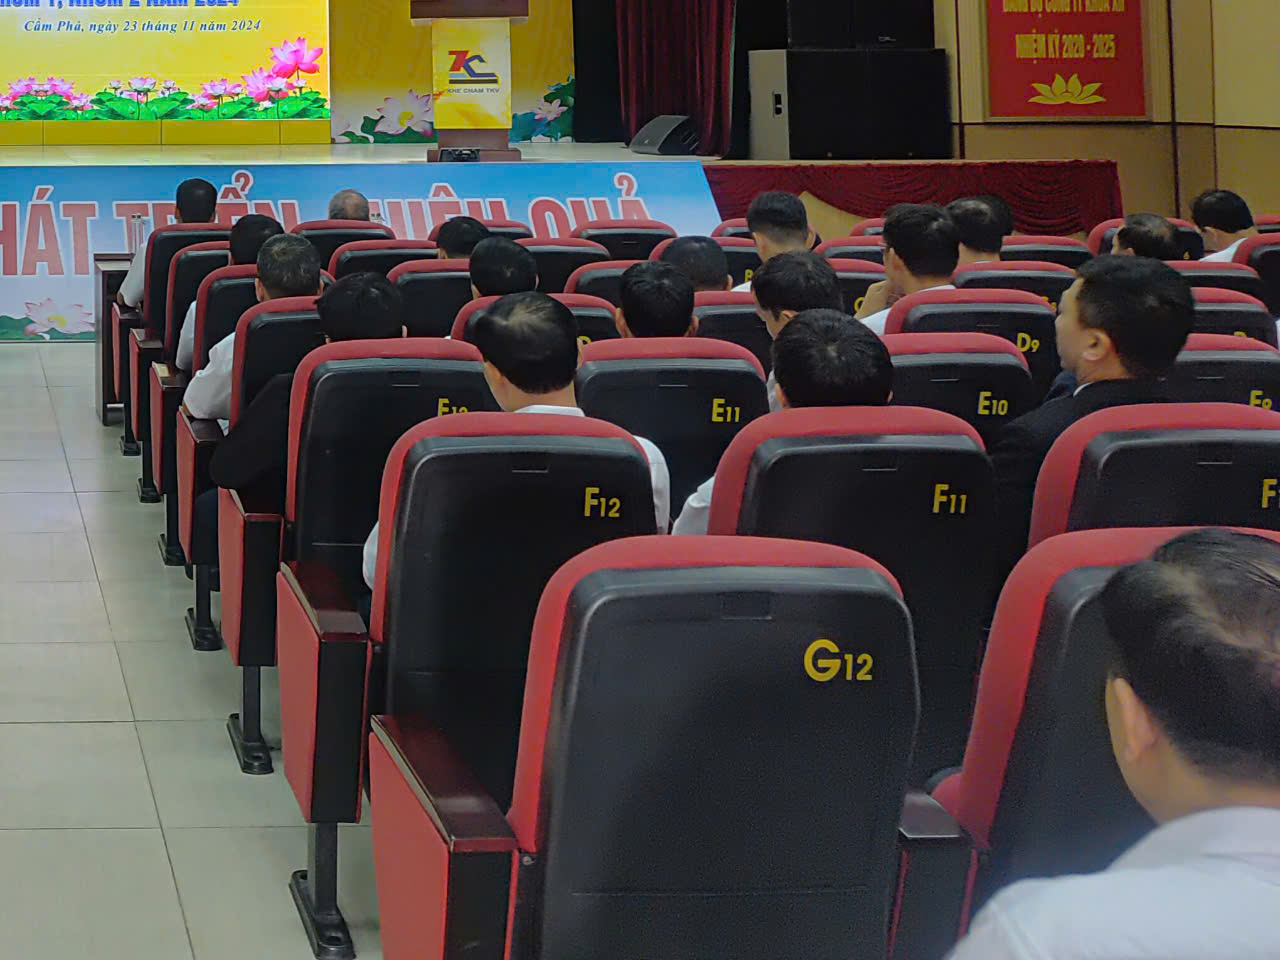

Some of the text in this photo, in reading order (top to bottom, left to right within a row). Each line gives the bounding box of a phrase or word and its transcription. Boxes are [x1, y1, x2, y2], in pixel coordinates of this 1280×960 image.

[89, 20, 119, 34] ngày
[142, 19, 177, 34] tháng
[199, 20, 228, 31] năm
[231, 19, 261, 31] 2024
[1017, 332, 1040, 353] D9
[712, 397, 740, 424] E11
[977, 391, 1009, 416] E10
[583, 486, 621, 518] F12
[932, 483, 967, 514] F11
[1261, 478, 1280, 509] F
[803, 638, 873, 682] G12
